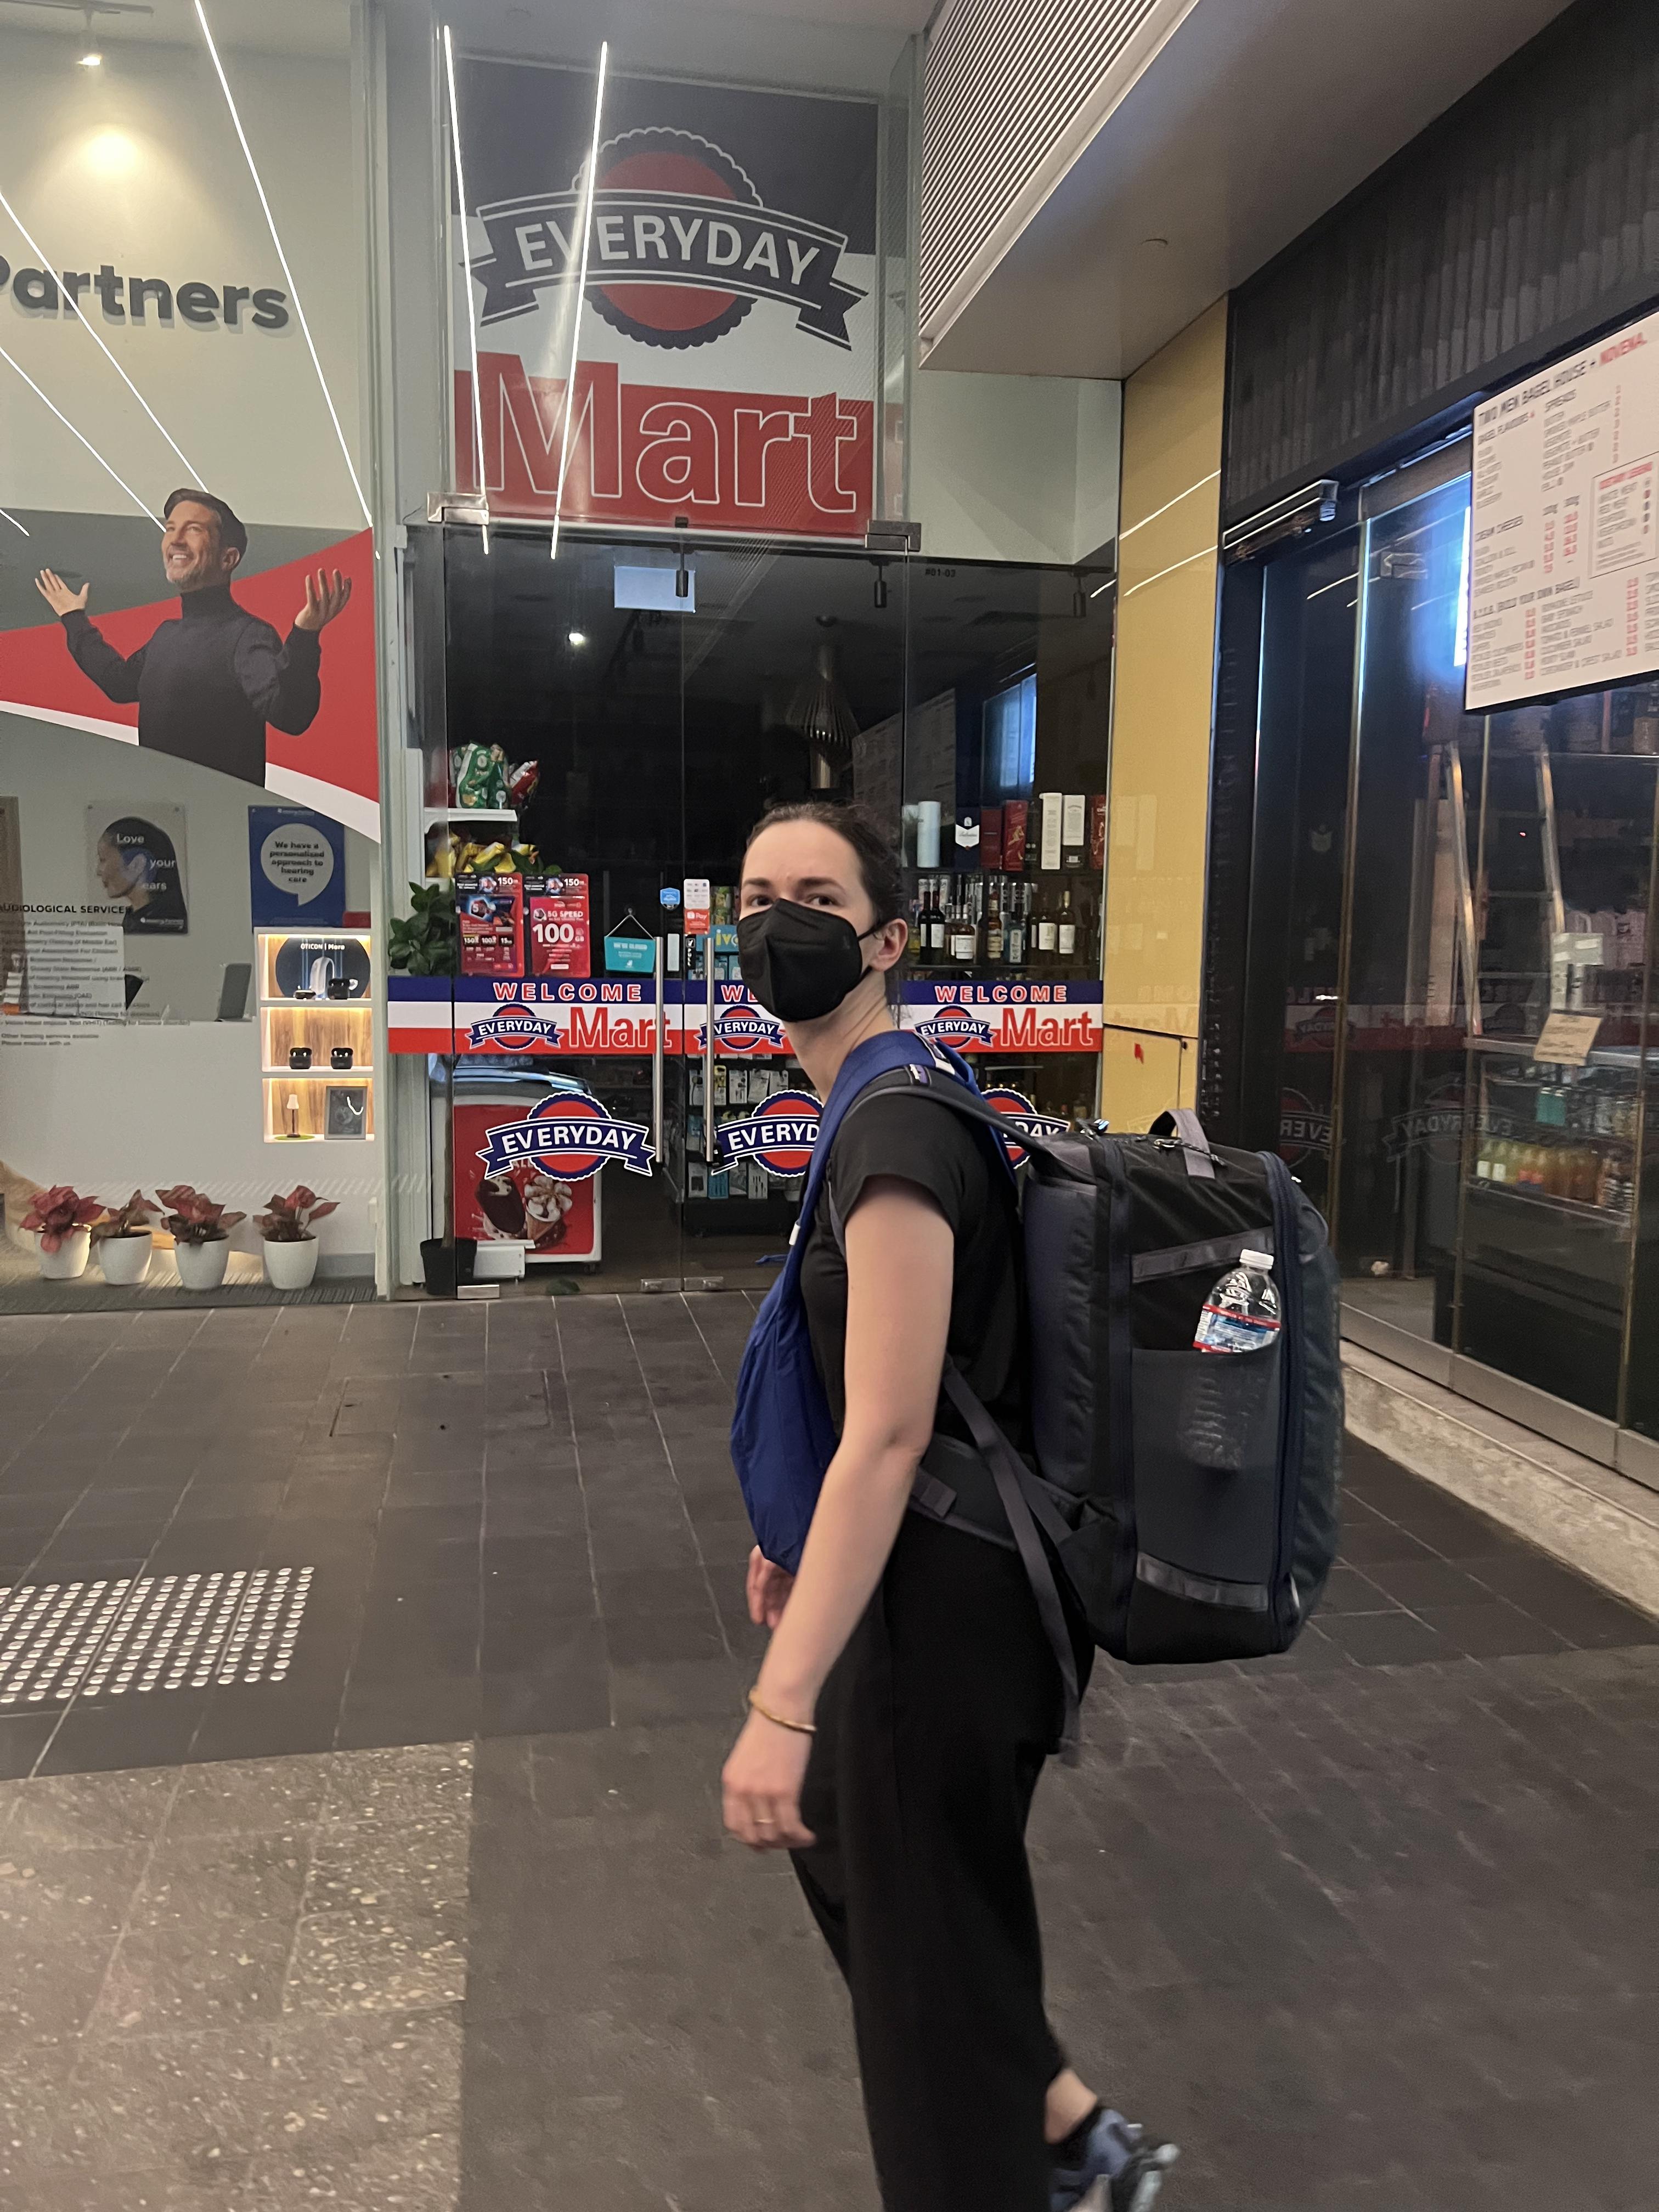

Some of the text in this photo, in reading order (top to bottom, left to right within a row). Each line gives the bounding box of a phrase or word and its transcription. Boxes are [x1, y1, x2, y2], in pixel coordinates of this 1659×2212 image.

[515, 215, 820, 285] EVERYDAY
[1553, 359, 1588, 388] HOUSE
[472, 351, 857, 514] Mart
[116, 833, 144, 844] Love
[149, 859, 176, 871] your
[272, 859, 312, 867] approach
[281, 867, 314, 876] hearing
[142, 882, 167, 890] ears
[532, 923, 574, 943] 100
[494, 981, 641, 1002] WELCOME
[934, 985, 1067, 1003] WELCOME
[478, 1006, 672, 1048] EVERYDAY Mart
[714, 1022, 775, 1035] VERYDAY
[920, 1007, 1094, 1047] EVERYDAY Mart
[501, 1125, 637, 1154] EVERYDAY
[727, 1123, 820, 1151] EVERYD
